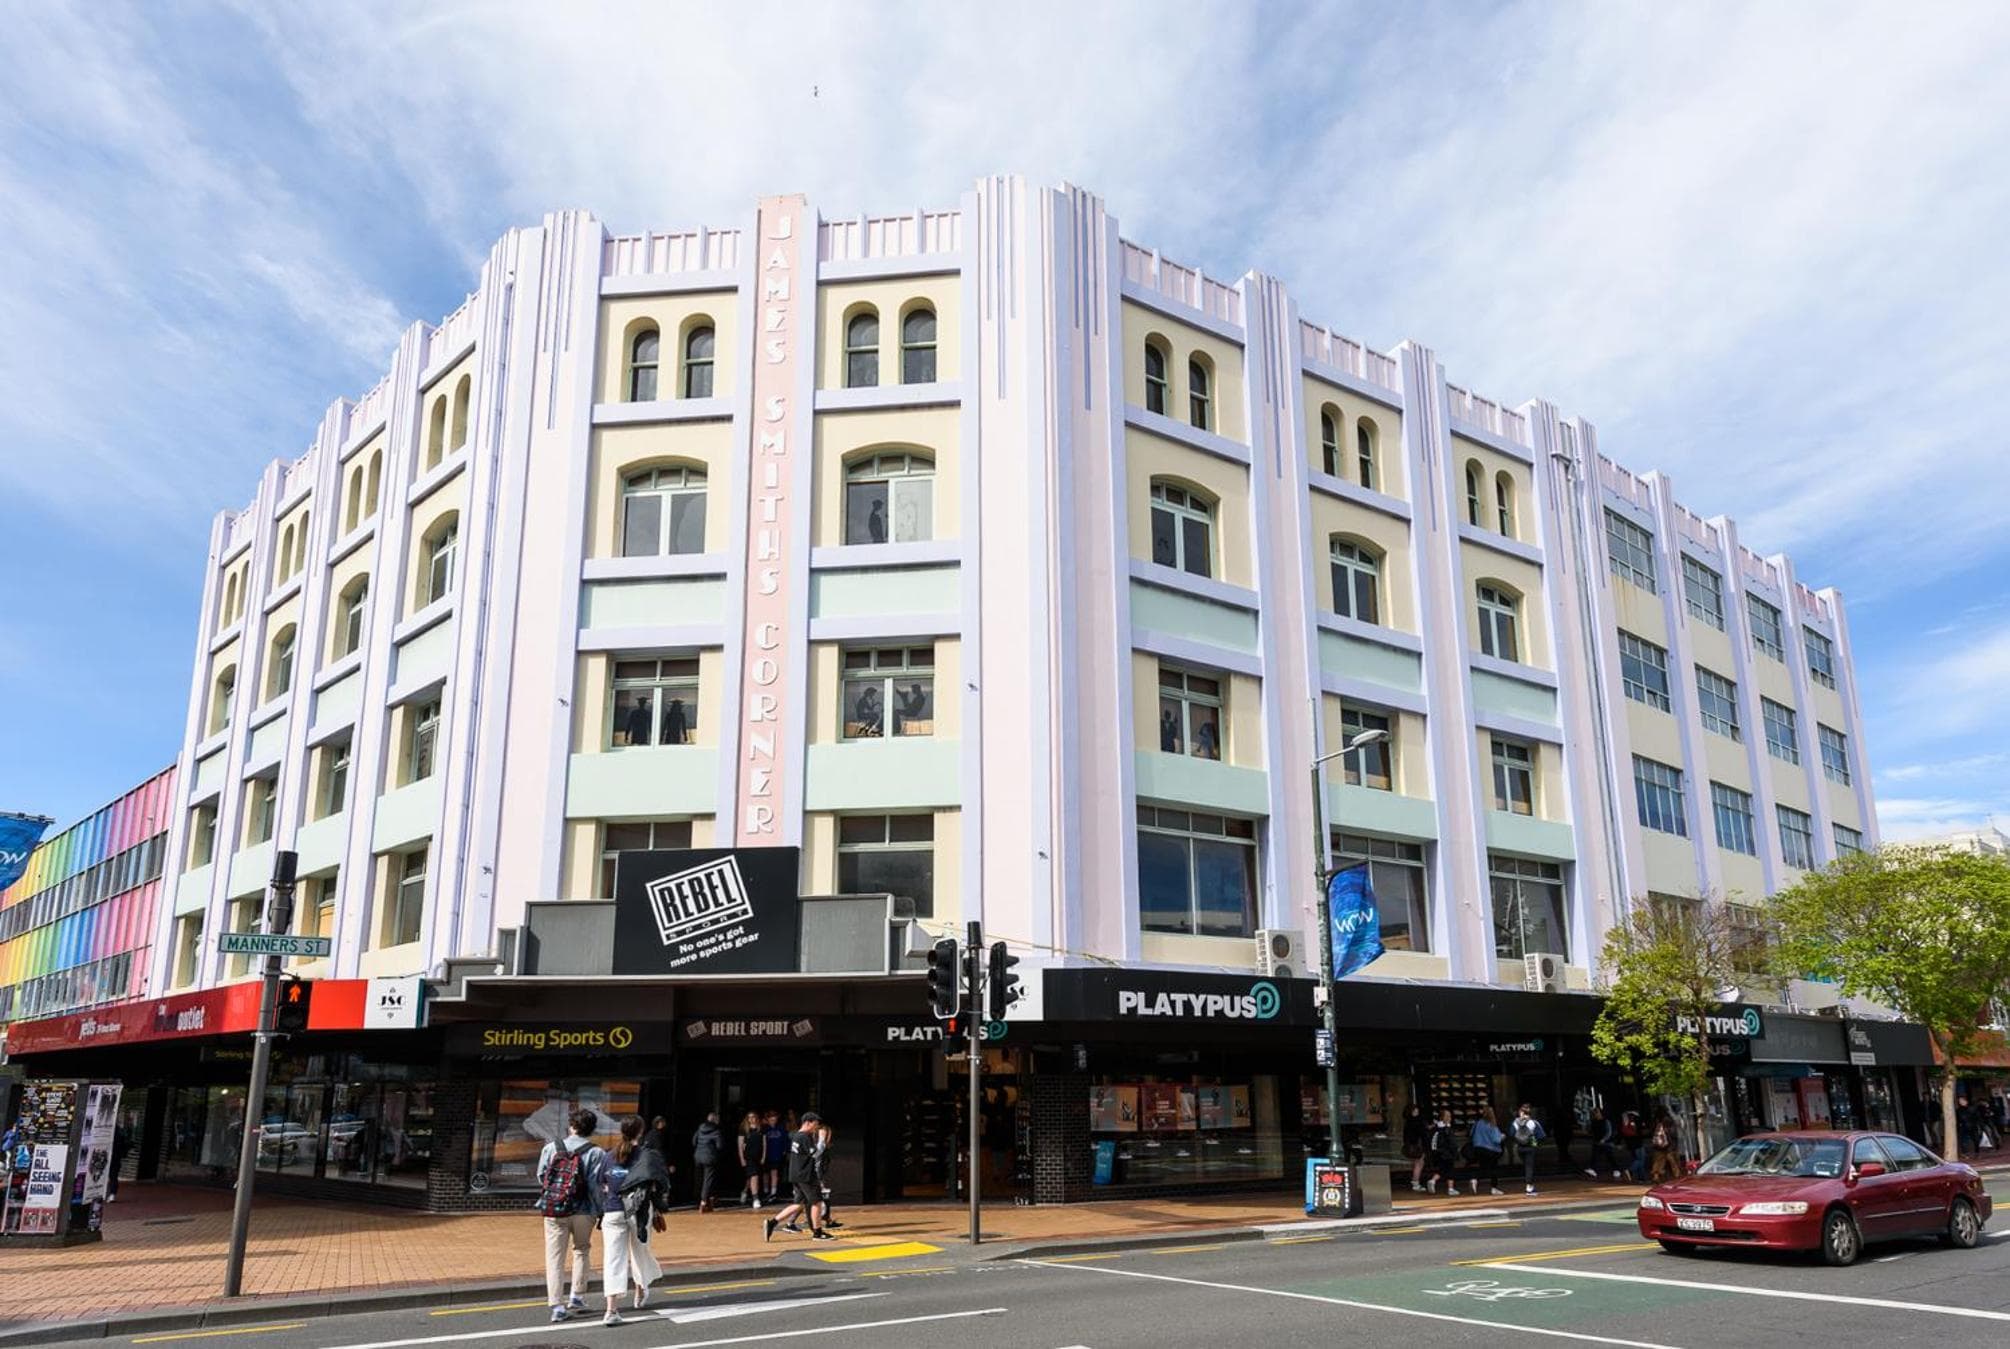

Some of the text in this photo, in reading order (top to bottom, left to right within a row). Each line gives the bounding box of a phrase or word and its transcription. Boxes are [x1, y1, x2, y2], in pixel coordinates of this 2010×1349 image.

[746, 215, 792, 835] JAMES SMITHS CORNER
[657, 868, 737, 925] REBEL
[669, 909, 744, 939] SPORT
[227, 936, 323, 953] MANNERS ST
[678, 925, 744, 954] No one's got
[670, 931, 760, 968] more sports gear
[1119, 990, 1257, 1018] PLATYPUS
[710, 1021, 746, 1036] REBEL
[750, 1020, 788, 1035] SPORT
[483, 1029, 605, 1048] Stirling Sports
[1489, 1043, 1536, 1052] PLATYPUS
[36, 1149, 48, 1157] THE
[34, 1159, 50, 1170] ALL
[31, 1171, 62, 1183] SEEING
[30, 1184, 54, 1195] HAND
